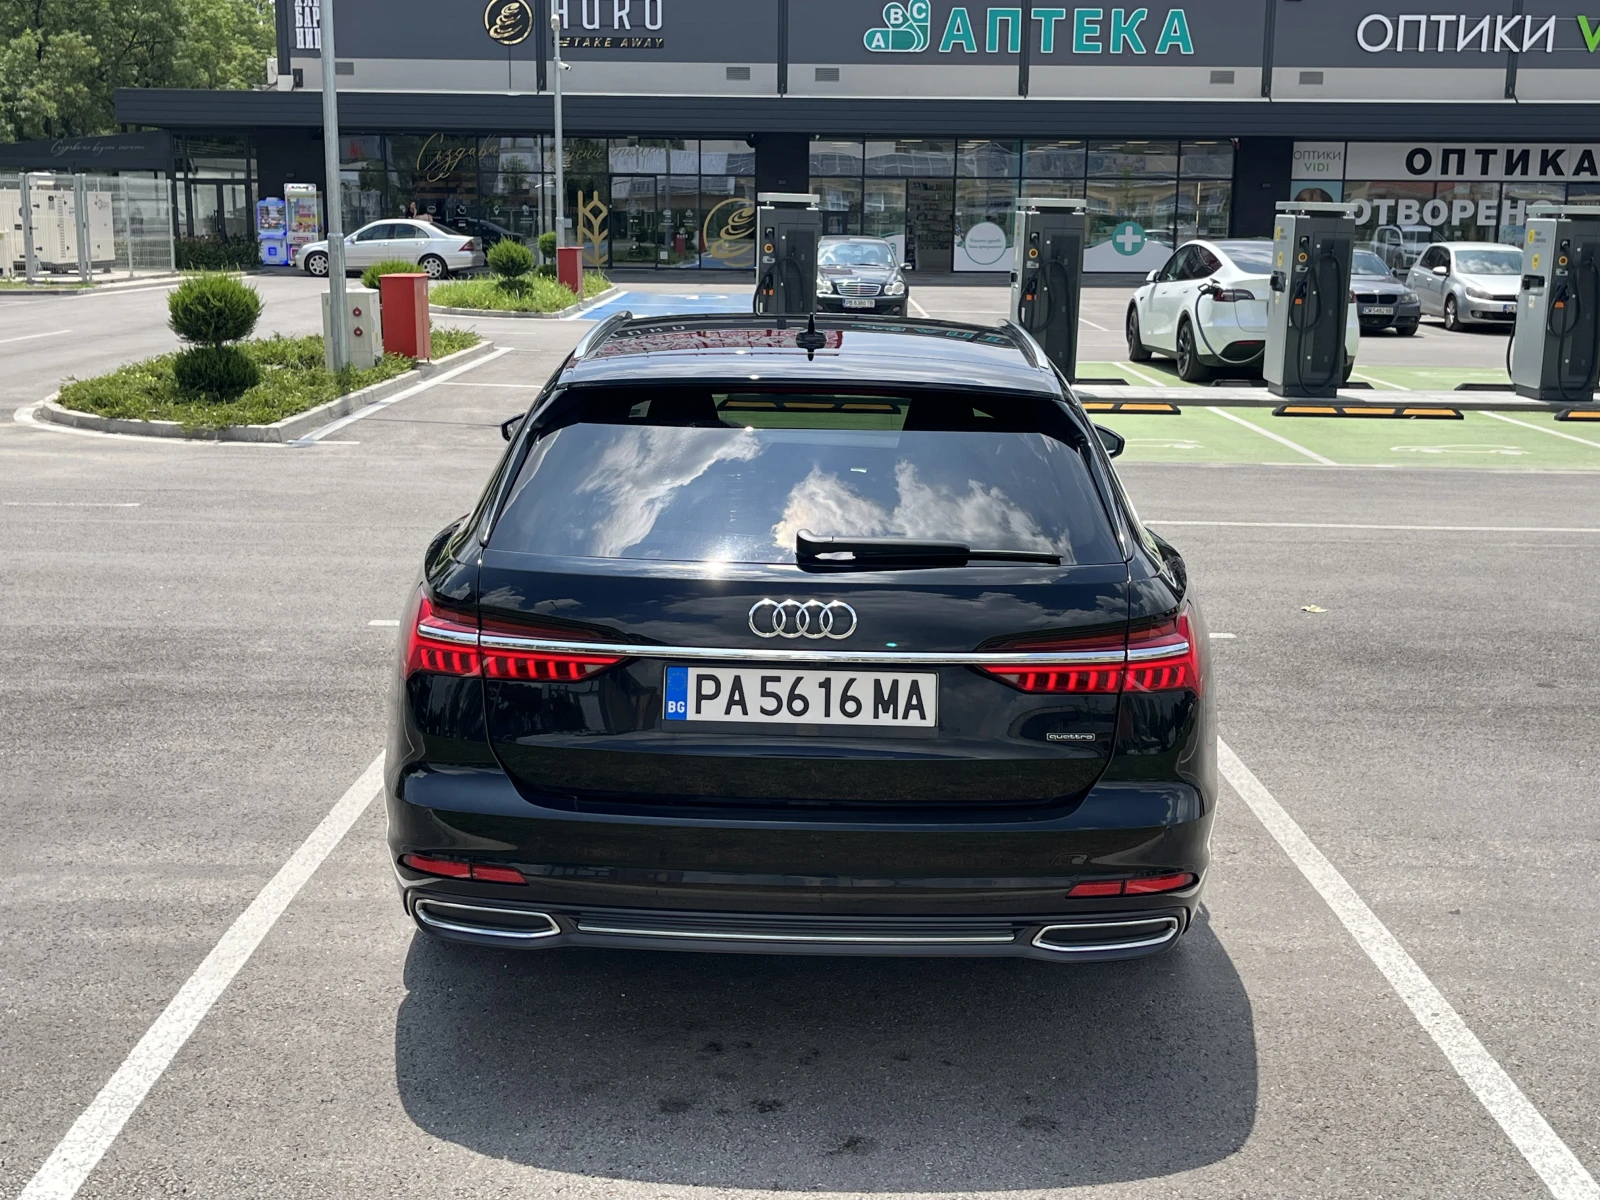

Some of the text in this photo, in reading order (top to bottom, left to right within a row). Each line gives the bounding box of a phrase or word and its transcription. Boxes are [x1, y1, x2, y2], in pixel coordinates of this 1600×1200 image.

[938, 7, 1195, 55] АПТЕКА
[1356, 14, 1556, 53] ОПТИКИ
[573, 37, 664, 48] TAKE AWAY
[1293, 150, 1342, 161] ОПТИКИ
[1405, 147, 1600, 176] ОПТИКА
[1303, 162, 1330, 172] VIDI
[1352, 199, 1553, 226] ОТВОРЕН
[667, 701, 686, 714] BG
